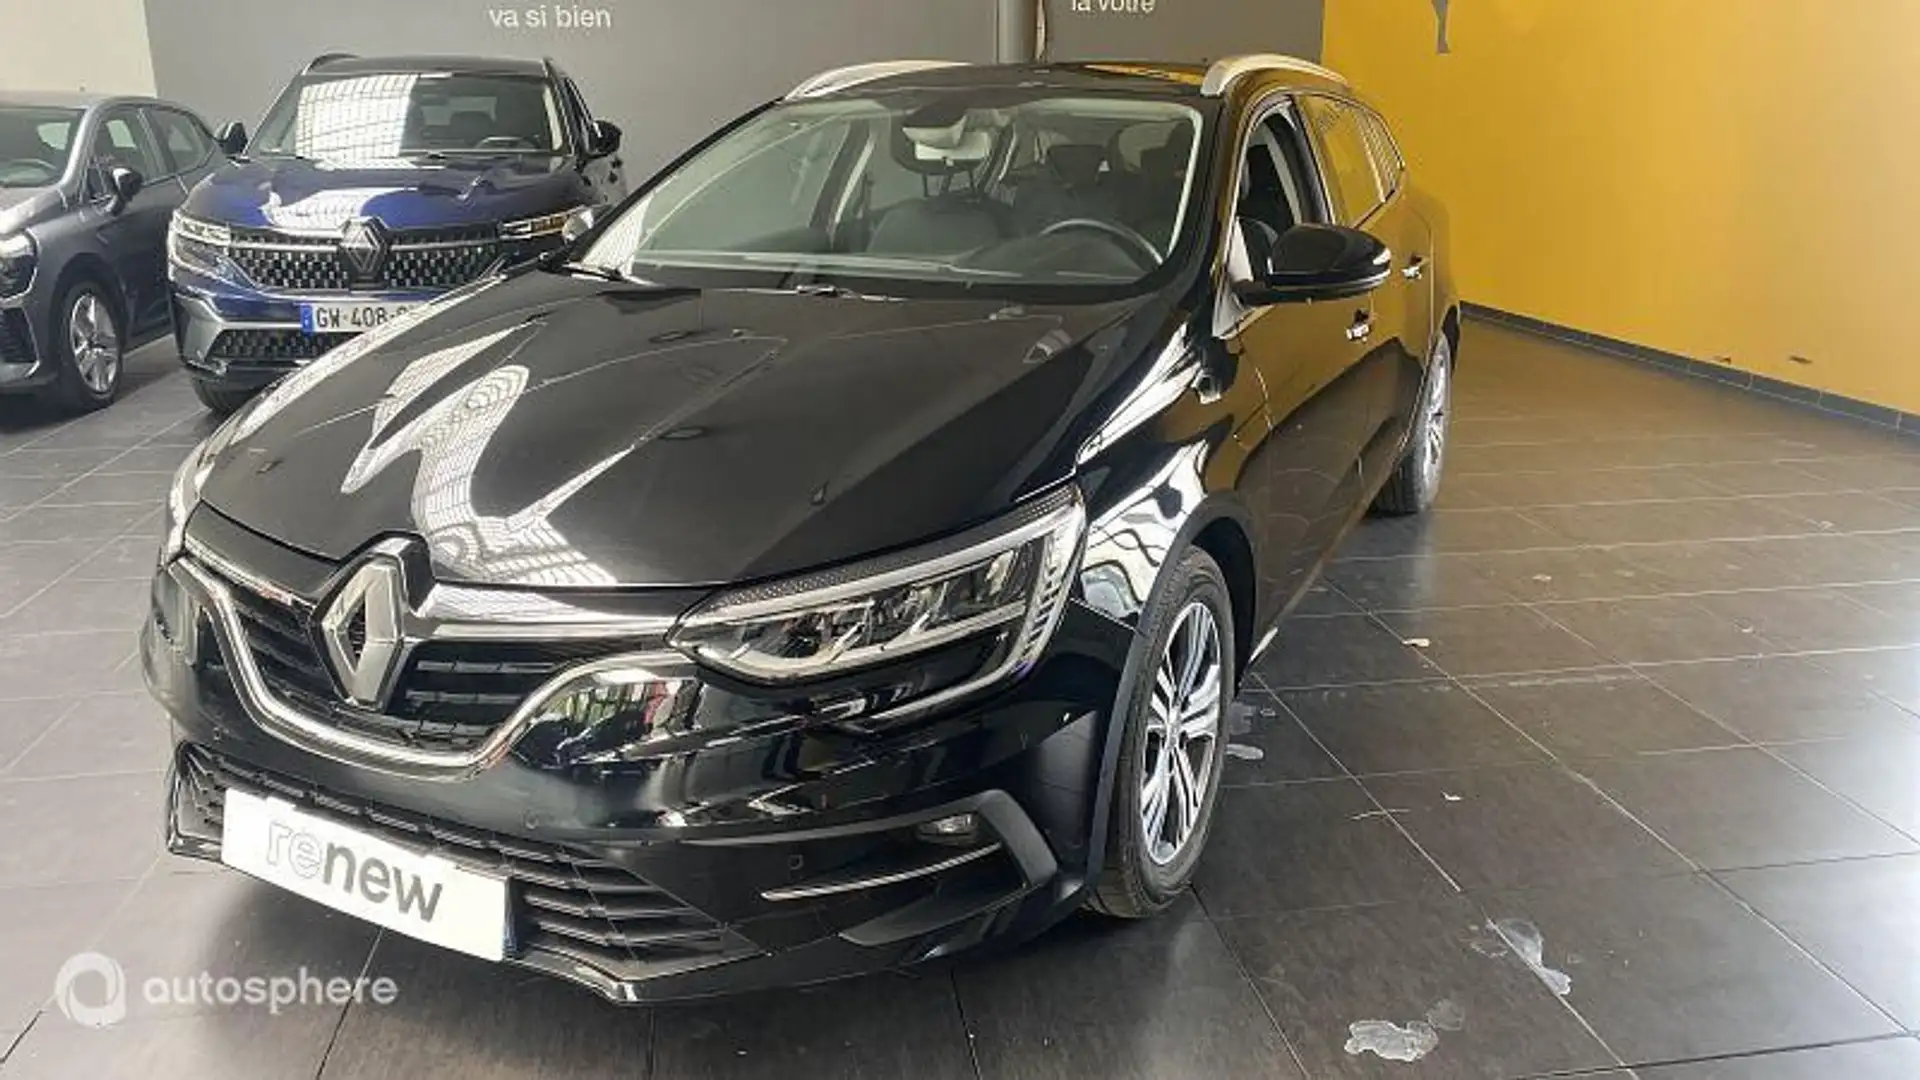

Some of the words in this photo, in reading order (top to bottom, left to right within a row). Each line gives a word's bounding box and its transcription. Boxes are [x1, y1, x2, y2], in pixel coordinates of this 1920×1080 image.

[489, 9, 519, 28] va
[525, 5, 547, 28] si
[555, 4, 612, 28] bien
[265, 821, 443, 923] renew
